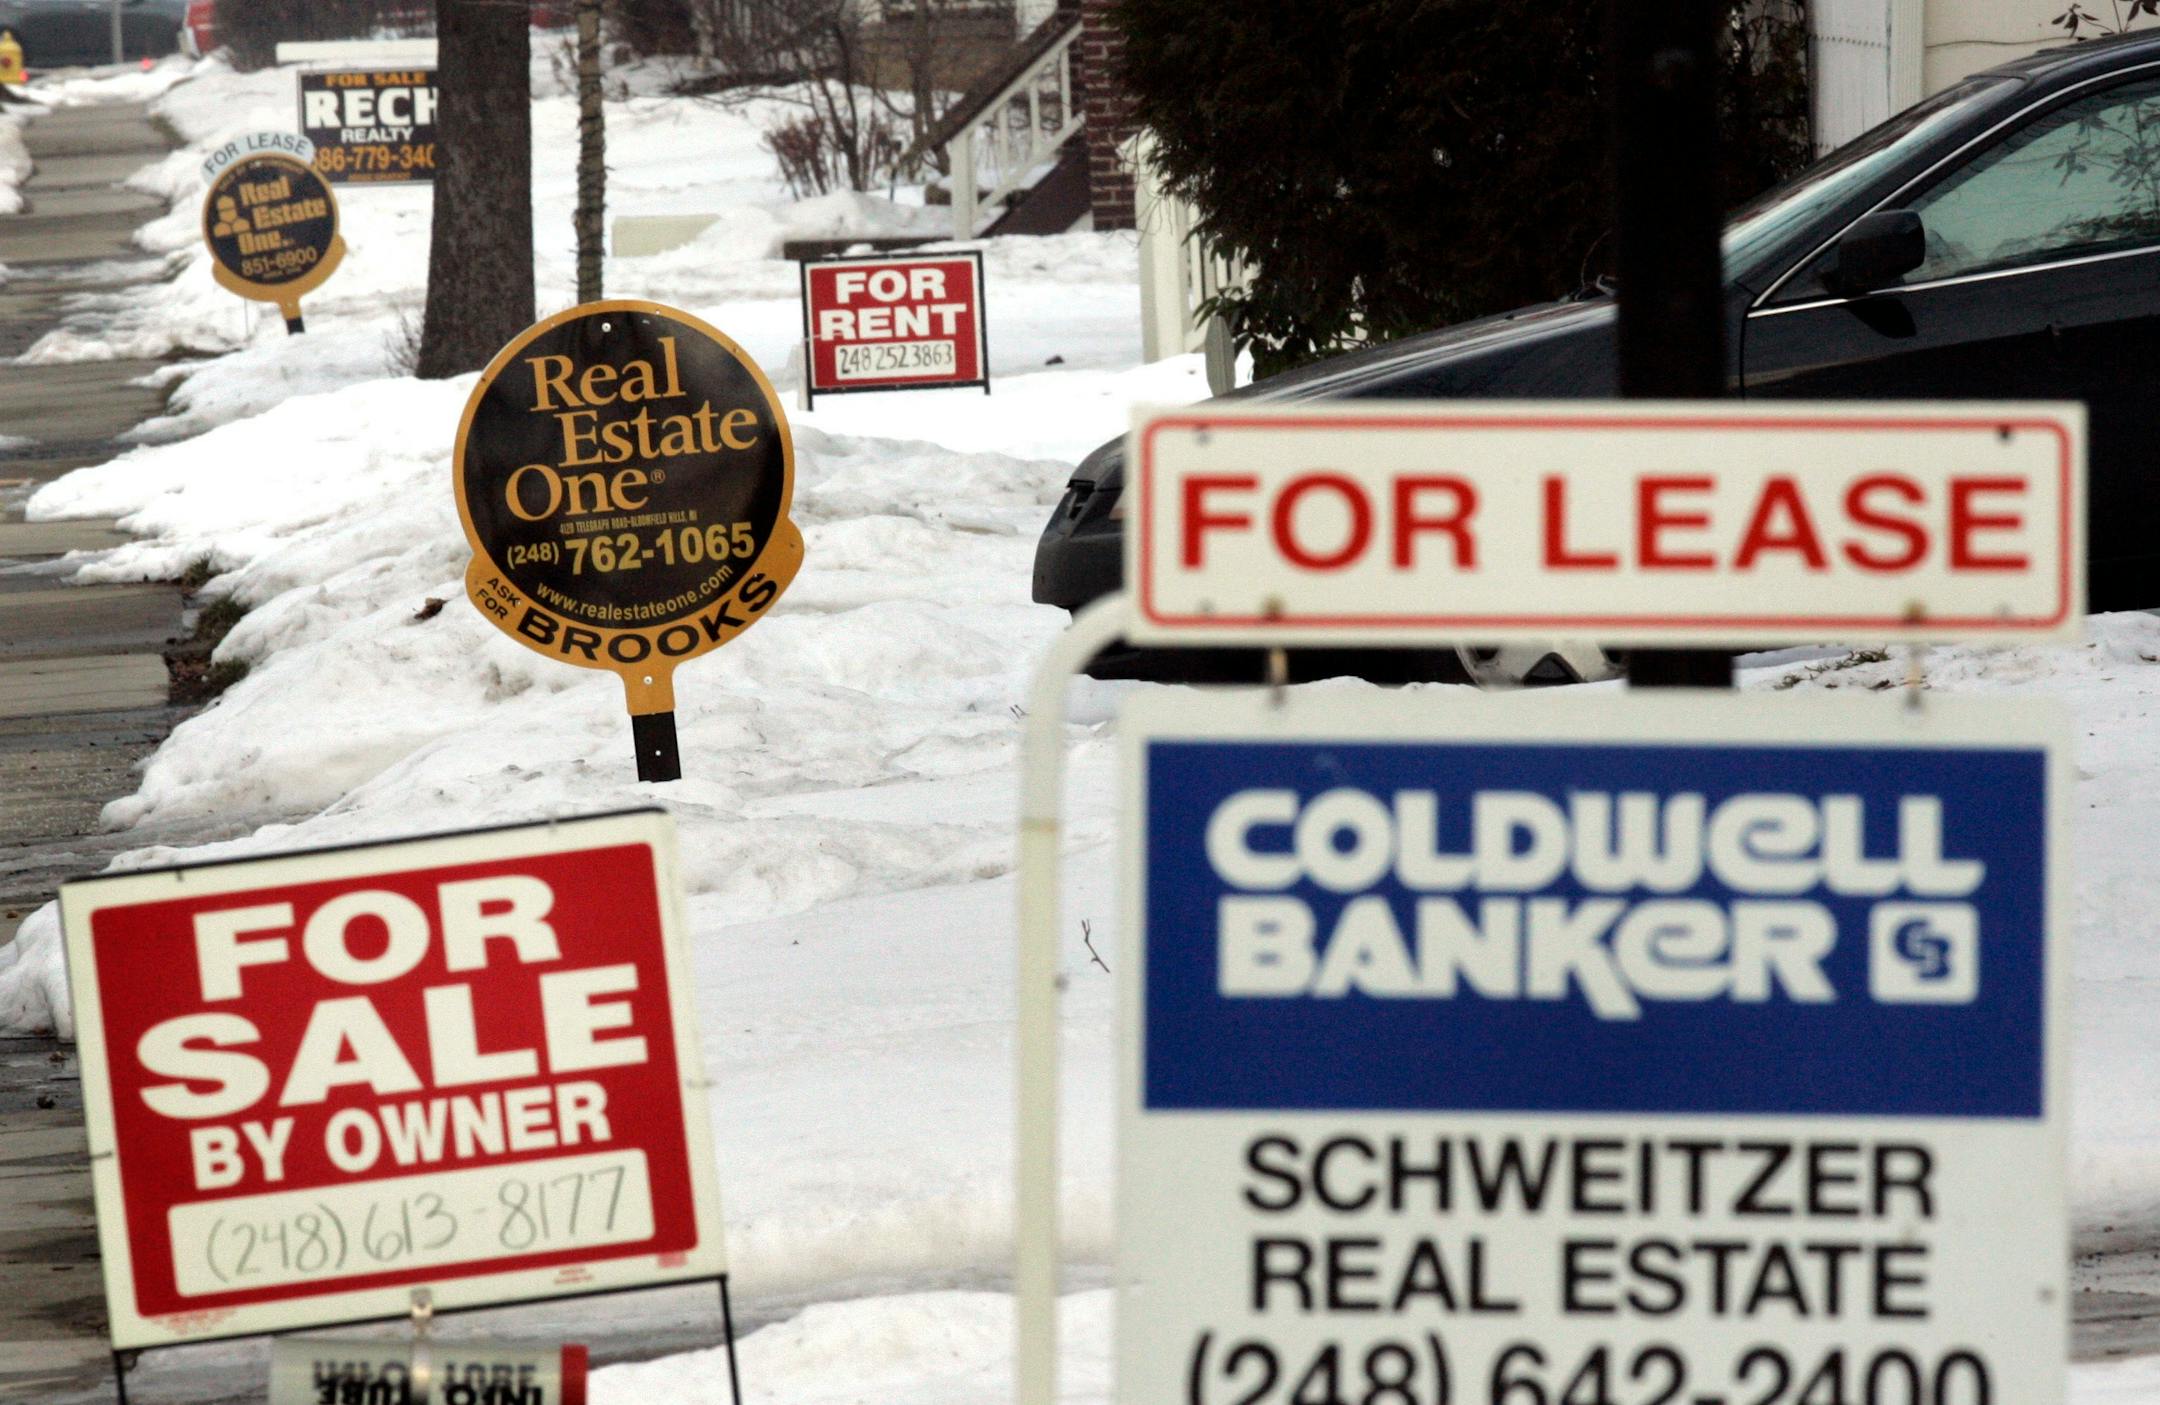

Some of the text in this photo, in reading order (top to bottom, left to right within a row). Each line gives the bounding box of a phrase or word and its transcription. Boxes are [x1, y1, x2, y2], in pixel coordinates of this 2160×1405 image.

[324, 71, 427, 87] FOR SALE
[204, 133, 306, 174] FOR LEASE
[315, 143, 436, 172] 86-779-340
[341, 127, 414, 143] REALTY
[240, 176, 291, 206] Real
[253, 198, 327, 229] Estate
[242, 247, 317, 276] 851-6900
[835, 268, 946, 304] FOR
[819, 303, 967, 341] RENT
[525, 336, 686, 412] Real
[553, 400, 758, 468] Estate
[506, 522, 756, 576] (248) 762-1065
[1179, 472, 2032, 574] FOR LEASE
[476, 588, 509, 620] FOR
[487, 577, 521, 608] ASK
[516, 573, 778, 664] BROOKS
[536, 563, 734, 621] www.realestateone.com
[1205, 788, 1986, 896] COLDWELL
[193, 874, 562, 1001] FOR
[1217, 894, 1836, 1021] BANKER
[136, 963, 648, 1119] SALE
[190, 1081, 611, 1190] BY OWNER
[1242, 1134, 1936, 1219] SCHWEITZER
[1251, 1237, 1929, 1317] REAL ESTATE
[1187, 1330, 1990, 1405] (248) 642-2400
